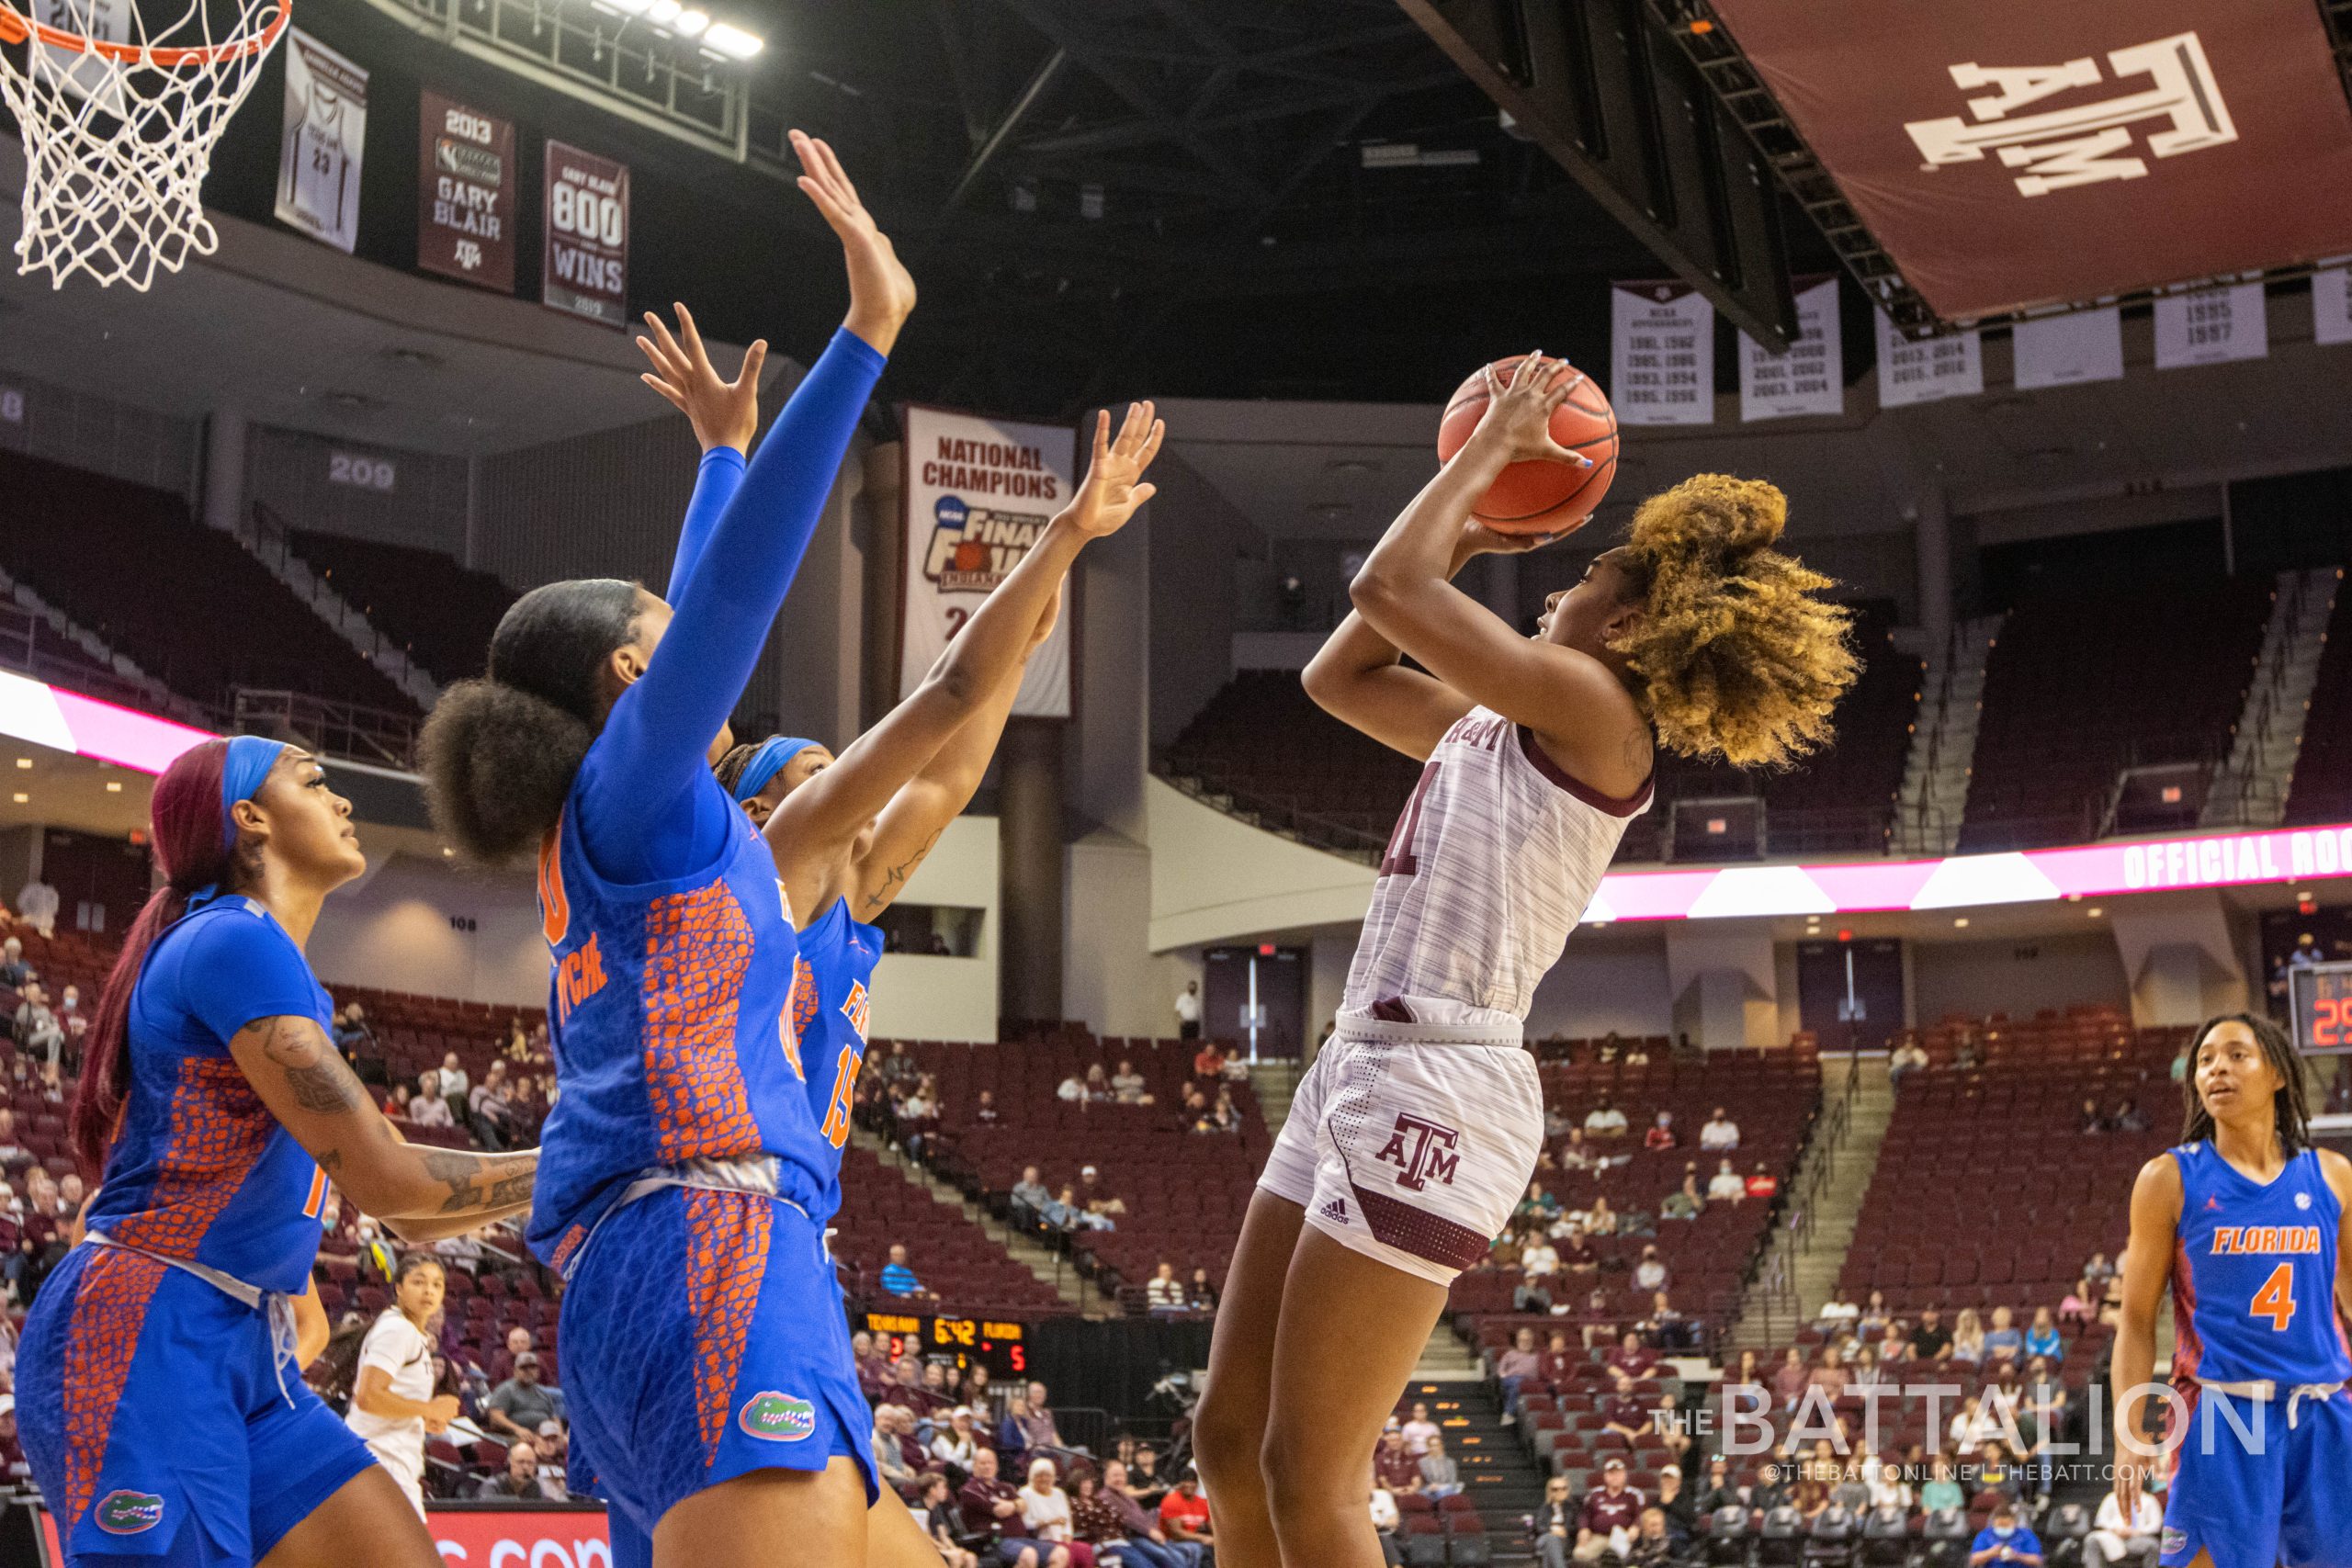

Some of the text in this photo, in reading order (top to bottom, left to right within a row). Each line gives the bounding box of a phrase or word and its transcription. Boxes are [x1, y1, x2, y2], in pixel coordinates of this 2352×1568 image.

[446, 109, 492, 144] 2013
[313, 147, 330, 175] 23
[437, 176, 498, 213] GARY
[434, 200, 501, 241] BLAIR
[553, 181, 622, 247] 800
[553, 243, 623, 294] WINS
[938, 436, 1043, 471] NATIONAL
[330, 455, 394, 490] 209
[922, 462, 1057, 500] CHAMPIONS
[2123, 835, 2279, 889] OFFICIAL
[450, 917, 476, 932] 108
[820, 1043, 862, 1150] 15
[1319, 1206, 1350, 1225] adidas
[2209, 1225, 2321, 1255] FLORIDA
[2249, 1261, 2297, 1332] 4
[934, 1319, 976, 1346] 6:42
[1011, 1345, 1025, 1371] 5
